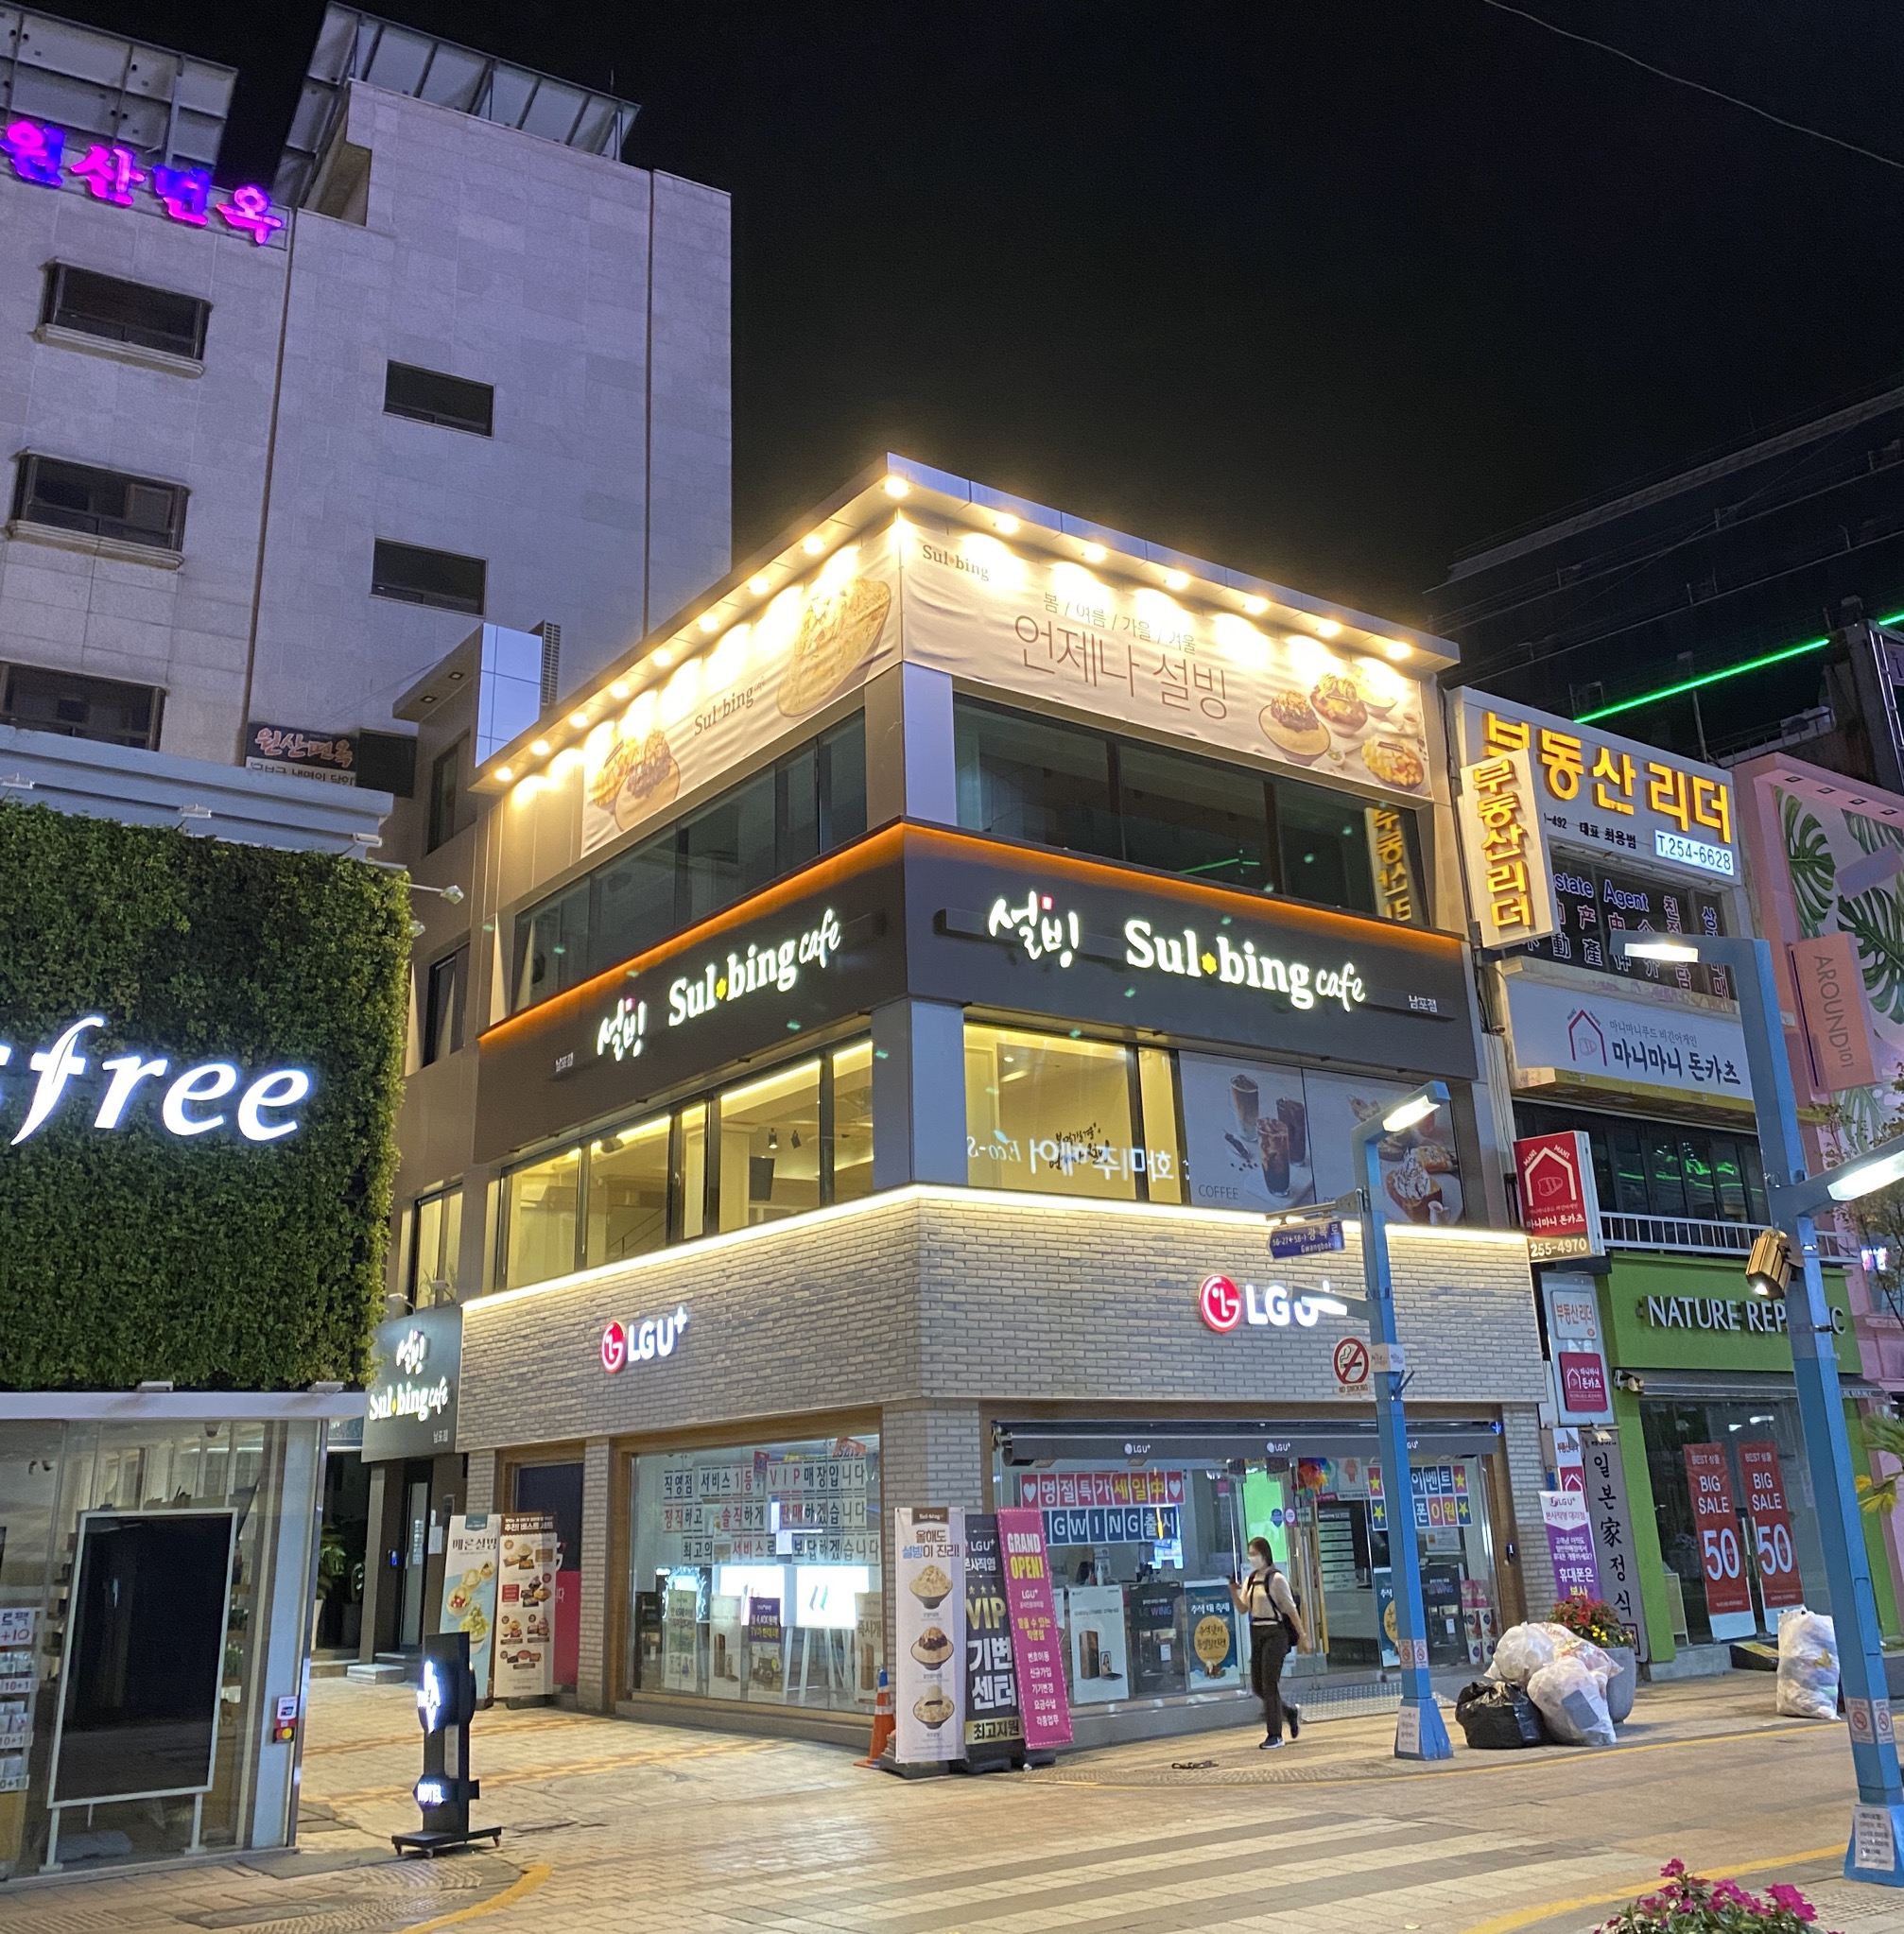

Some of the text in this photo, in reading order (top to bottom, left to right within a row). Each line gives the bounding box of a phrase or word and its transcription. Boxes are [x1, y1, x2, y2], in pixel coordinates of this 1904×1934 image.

[1044, 592, 1059, 615] 봄
[1076, 602, 1106, 625] 여름
[1123, 615, 1152, 641] 가을
[1014, 613, 1227, 720] 언제나 설빙
[255, 727, 353, 768] 원산면옥
[1473, 759, 1532, 928] 부동산리더
[1580, 821, 1600, 838] 대표
[1604, 827, 1636, 849] 최용범
[1657, 834, 1731, 871] T.254-6628
[1553, 872, 1650, 912] state Agent
[798, 908, 841, 969] cafe
[1314, 961, 1365, 1011] cafe
[1409, 993, 1438, 1012] 남포점
[1612, 1038, 1740, 1085] 마니마니 돈카츠
[0, 1015, 309, 1146] free
[1198, 1183, 1238, 1200] COFFEE
[1560, 1213, 1584, 1226] 돈카츠
[1307, 1223, 1340, 1241] 광복로
[1530, 1237, 1587, 1258] 255-4970
[1556, 1304, 1594, 1325] 부동산리더
[1647, 1295, 1846, 1335] NATURE REPC
[1339, 1384, 1368, 1394] NO SMOKING
[1691, 1455, 1707, 1464] BEST
[1745, 1453, 1760, 1462] BEST
[664, 1474, 692, 1495] 직영점
[1700, 1476, 1721, 1493] BIG
[1753, 1473, 1773, 1489] BIG
[1698, 1496, 1730, 1514] SALE
[1752, 1494, 1782, 1511] SALE
[664, 1505, 702, 1529] 정직하고
[721, 1503, 764, 1528] 솔직하게
[916, 1529, 946, 1544] 올해도
[1007, 1533, 1040, 1554] GRAND
[684, 1537, 879, 1562] 최고의 서비스로 보답하겠습니다
[902, 1544, 960, 1559] 설빙이 진리!
[1704, 1528, 1740, 1581] 50
[1757, 1524, 1792, 1576] 50
[1010, 1556, 1044, 1580] OPEN!
[1559, 1567, 1594, 1582] 휴대폰은
[966, 1597, 1007, 1631] VIP
[1151, 1606, 1172, 1616] WING
[966, 1635, 1013, 1672] 기변
[1027, 1651, 1050, 1664] 번호이동
[1030, 1667, 1052, 1679] 신규가입
[971, 1674, 1017, 1711] 센터
[1031, 1683, 1054, 1695] 기기변경
[1034, 1699, 1056, 1711] 요금수납
[974, 1719, 1020, 1740] 최고지원
[1036, 1714, 1059, 1727] 각종업무
